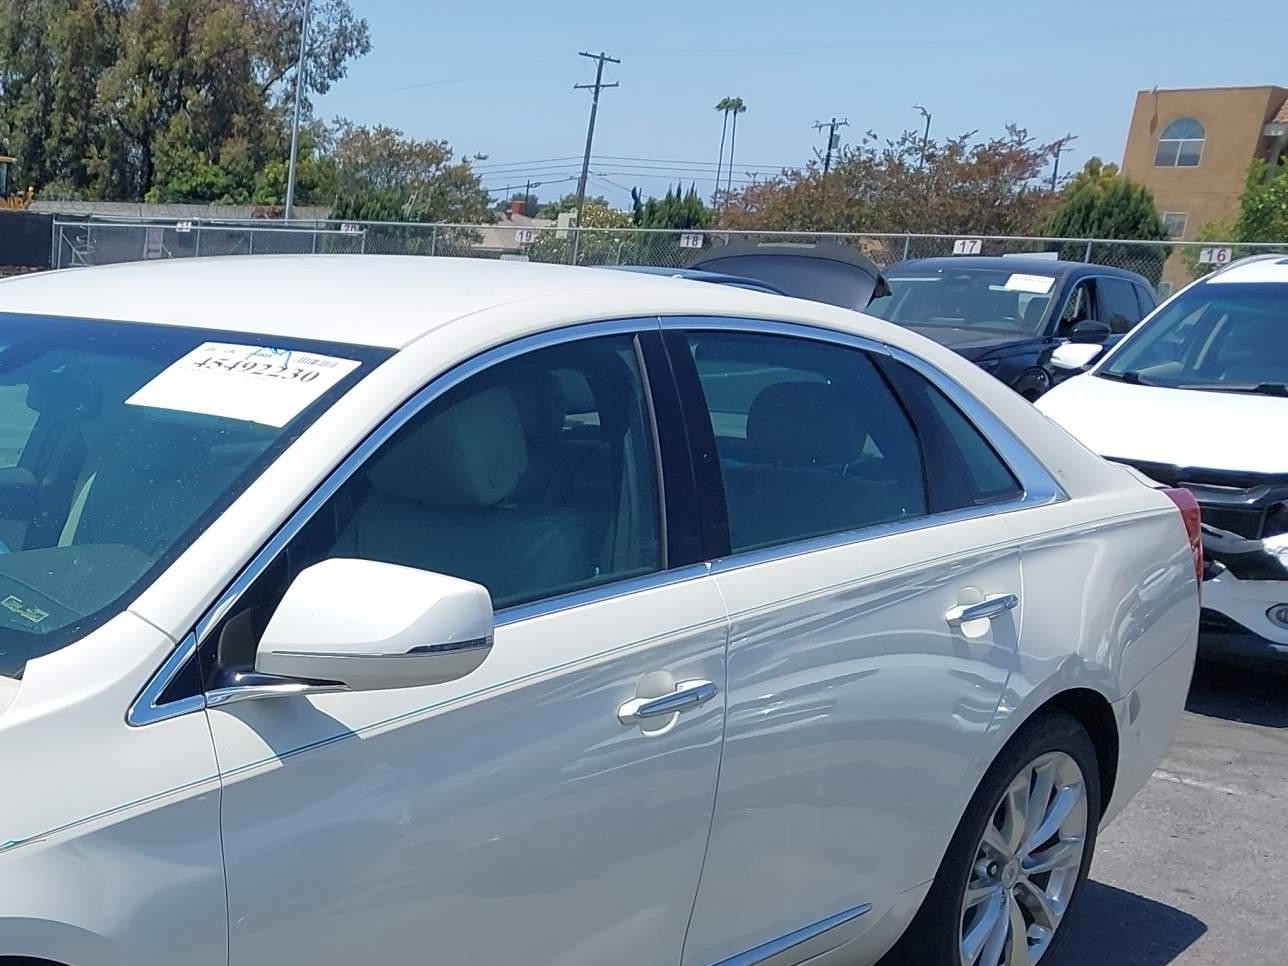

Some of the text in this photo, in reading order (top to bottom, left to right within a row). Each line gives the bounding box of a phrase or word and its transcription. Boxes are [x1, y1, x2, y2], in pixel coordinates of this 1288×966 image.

[519, 230, 532, 242] 19
[685, 235, 699, 246] 18
[959, 240, 977, 253] 17
[1206, 249, 1226, 262] 16
[193, 357, 320, 382] 45492230
